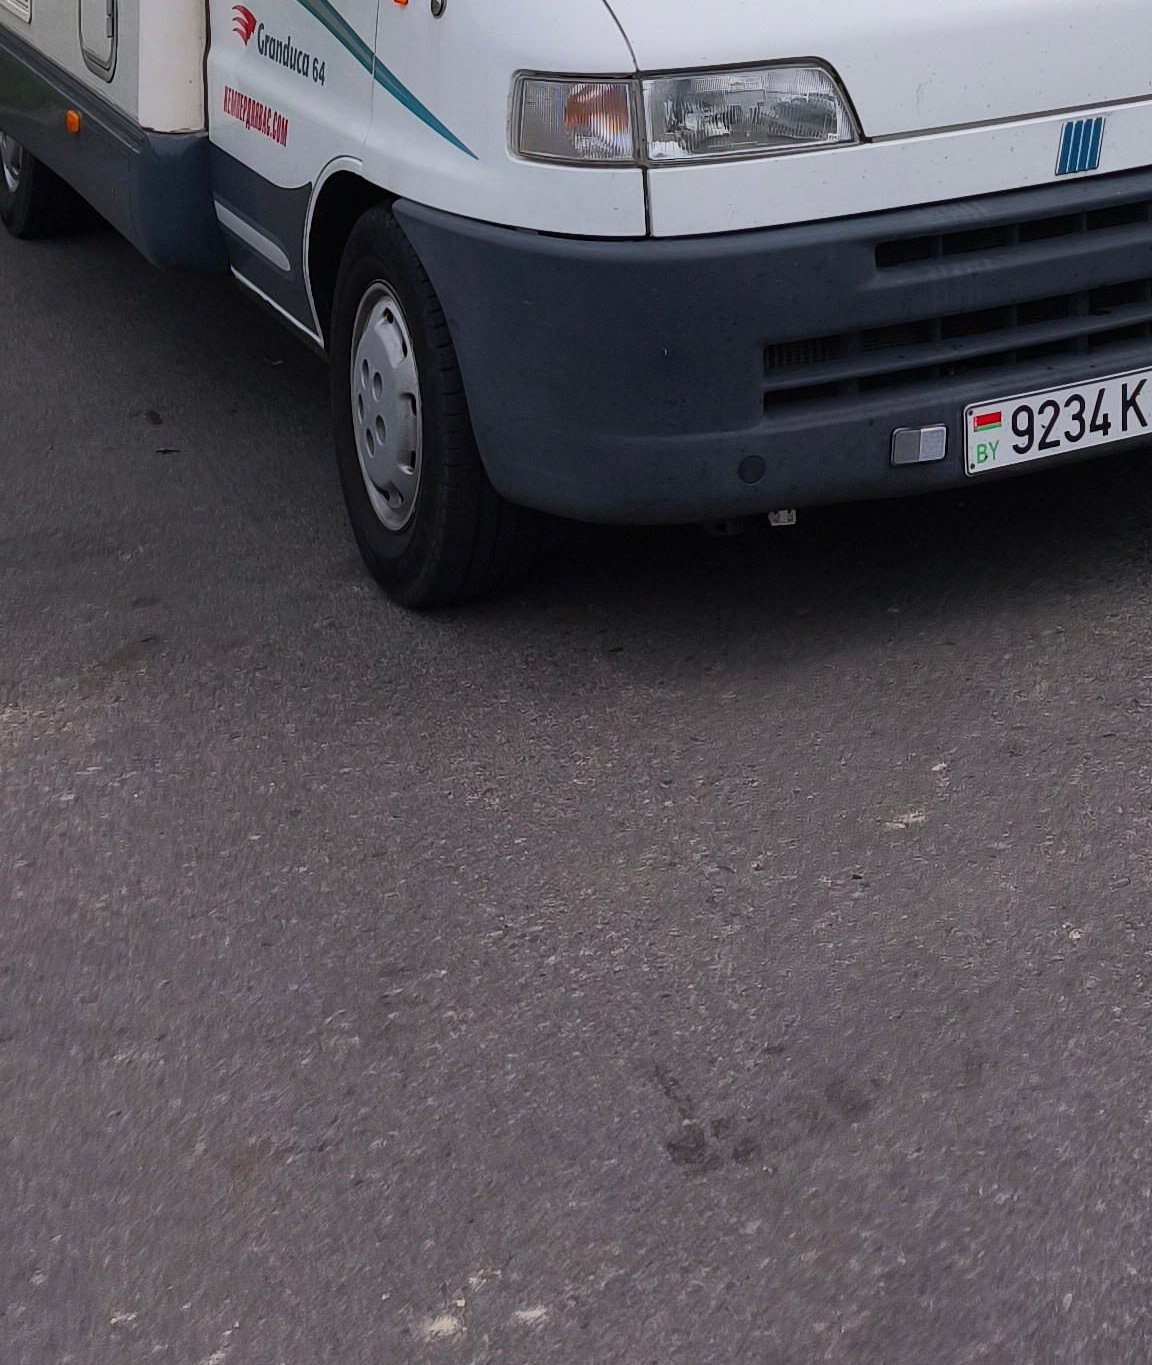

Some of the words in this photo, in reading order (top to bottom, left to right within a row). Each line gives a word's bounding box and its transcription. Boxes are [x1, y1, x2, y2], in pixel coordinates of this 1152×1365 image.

[257, 22, 310, 78] Granduca
[312, 56, 326, 86] 64
[976, 440, 999, 464] BY
